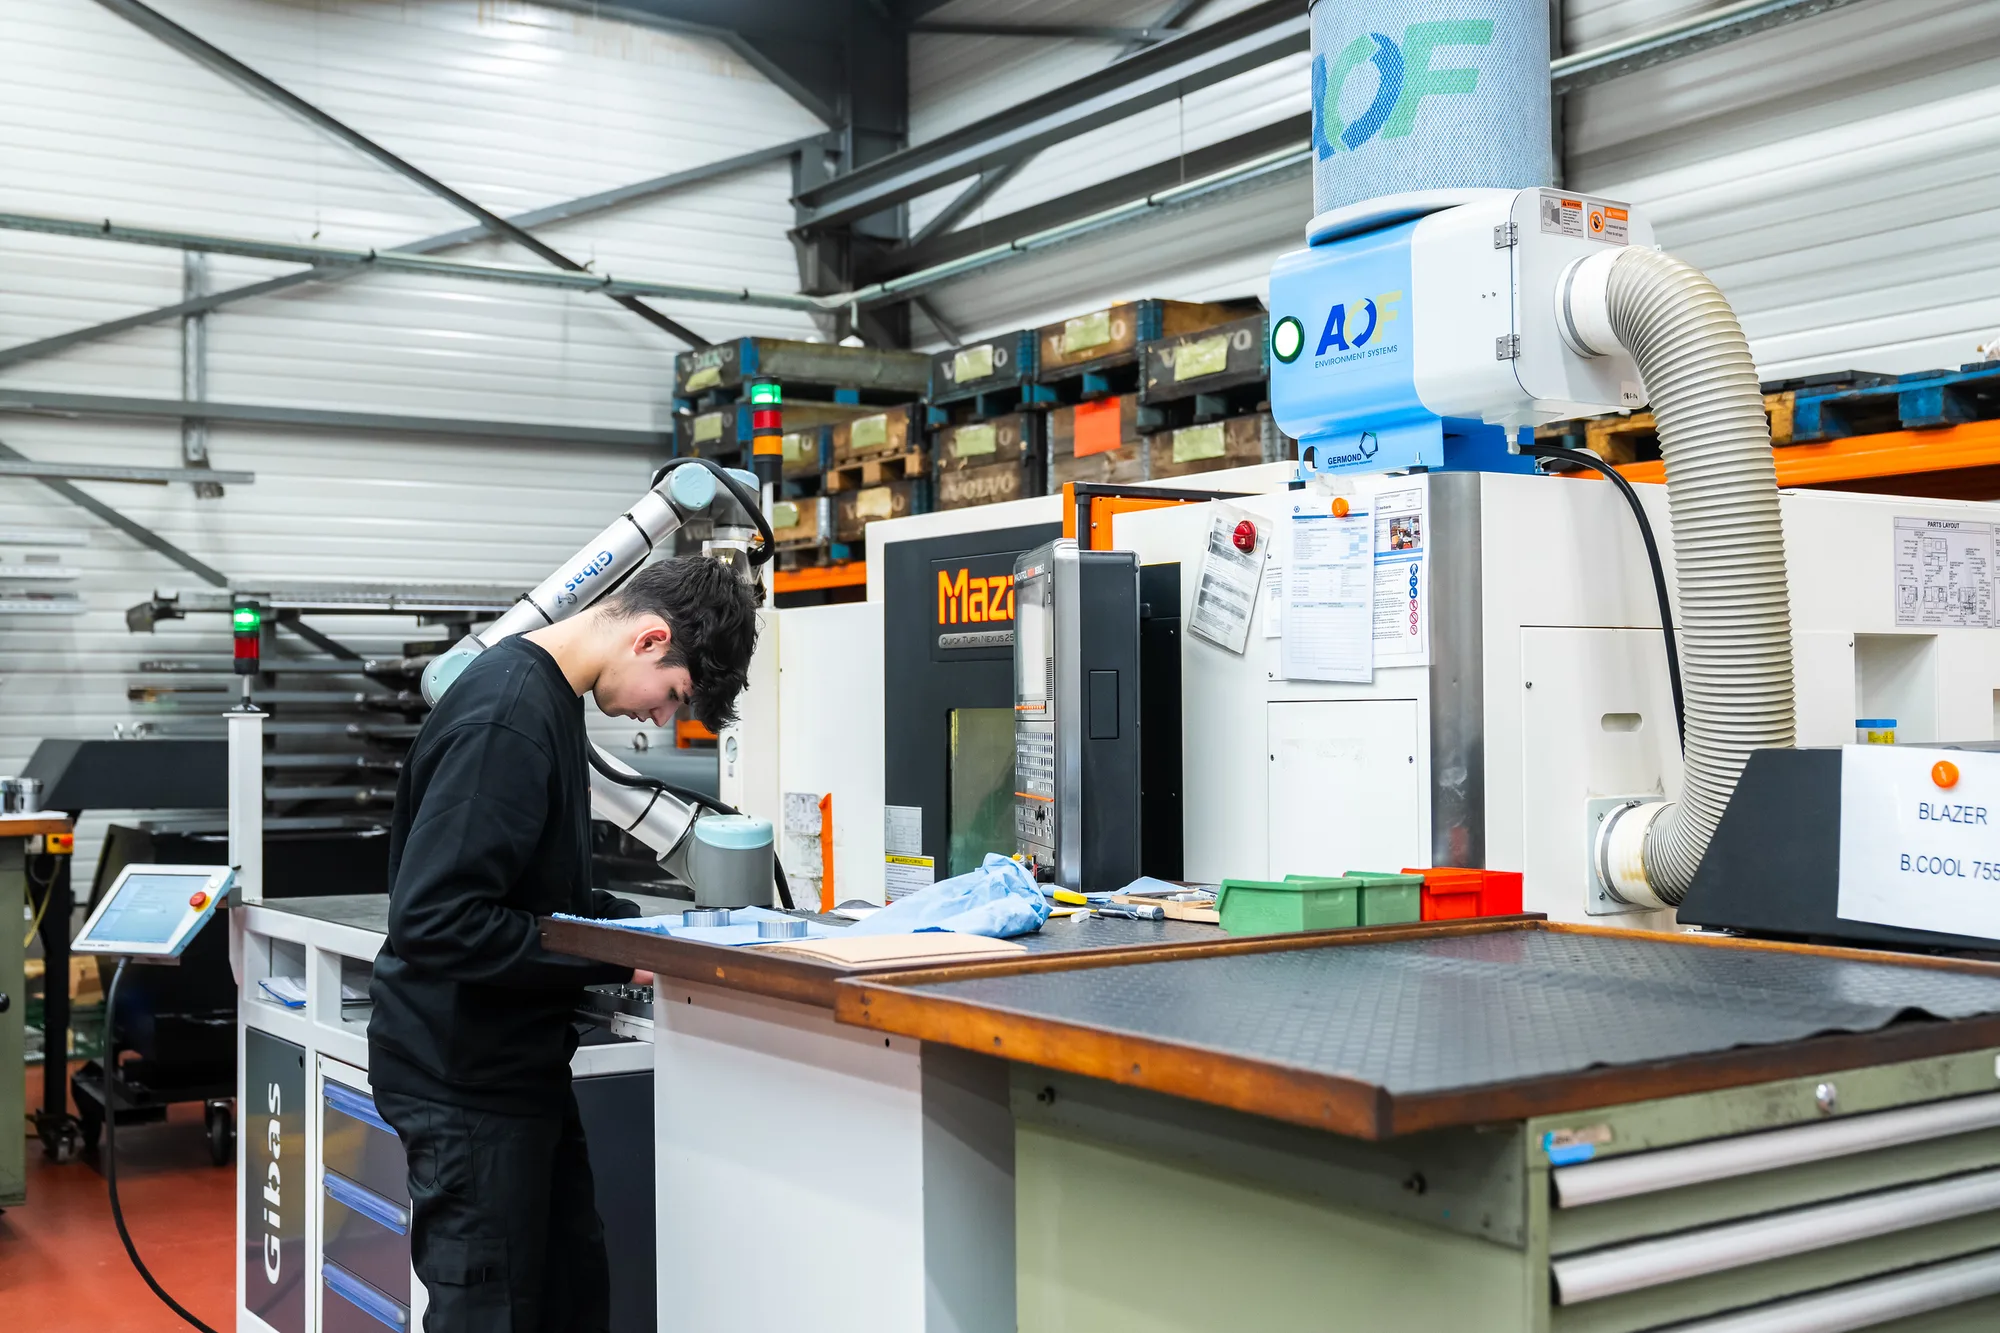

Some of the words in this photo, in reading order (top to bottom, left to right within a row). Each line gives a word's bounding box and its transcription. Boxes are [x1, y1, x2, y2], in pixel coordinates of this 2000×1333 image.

[1315, 290, 1402, 356] AOF
[1315, 351, 1365, 368] ENVIRONMENT
[1367, 345, 1398, 358] SYSTEMS
[1328, 453, 1362, 465] GERMOND
[949, 471, 1015, 501] VOLVO
[565, 551, 613, 592] Gibas
[1919, 802, 1987, 825] BLAZER
[1900, 853, 1966, 878] B.COOL
[264, 1082, 281, 1285] Gibas
